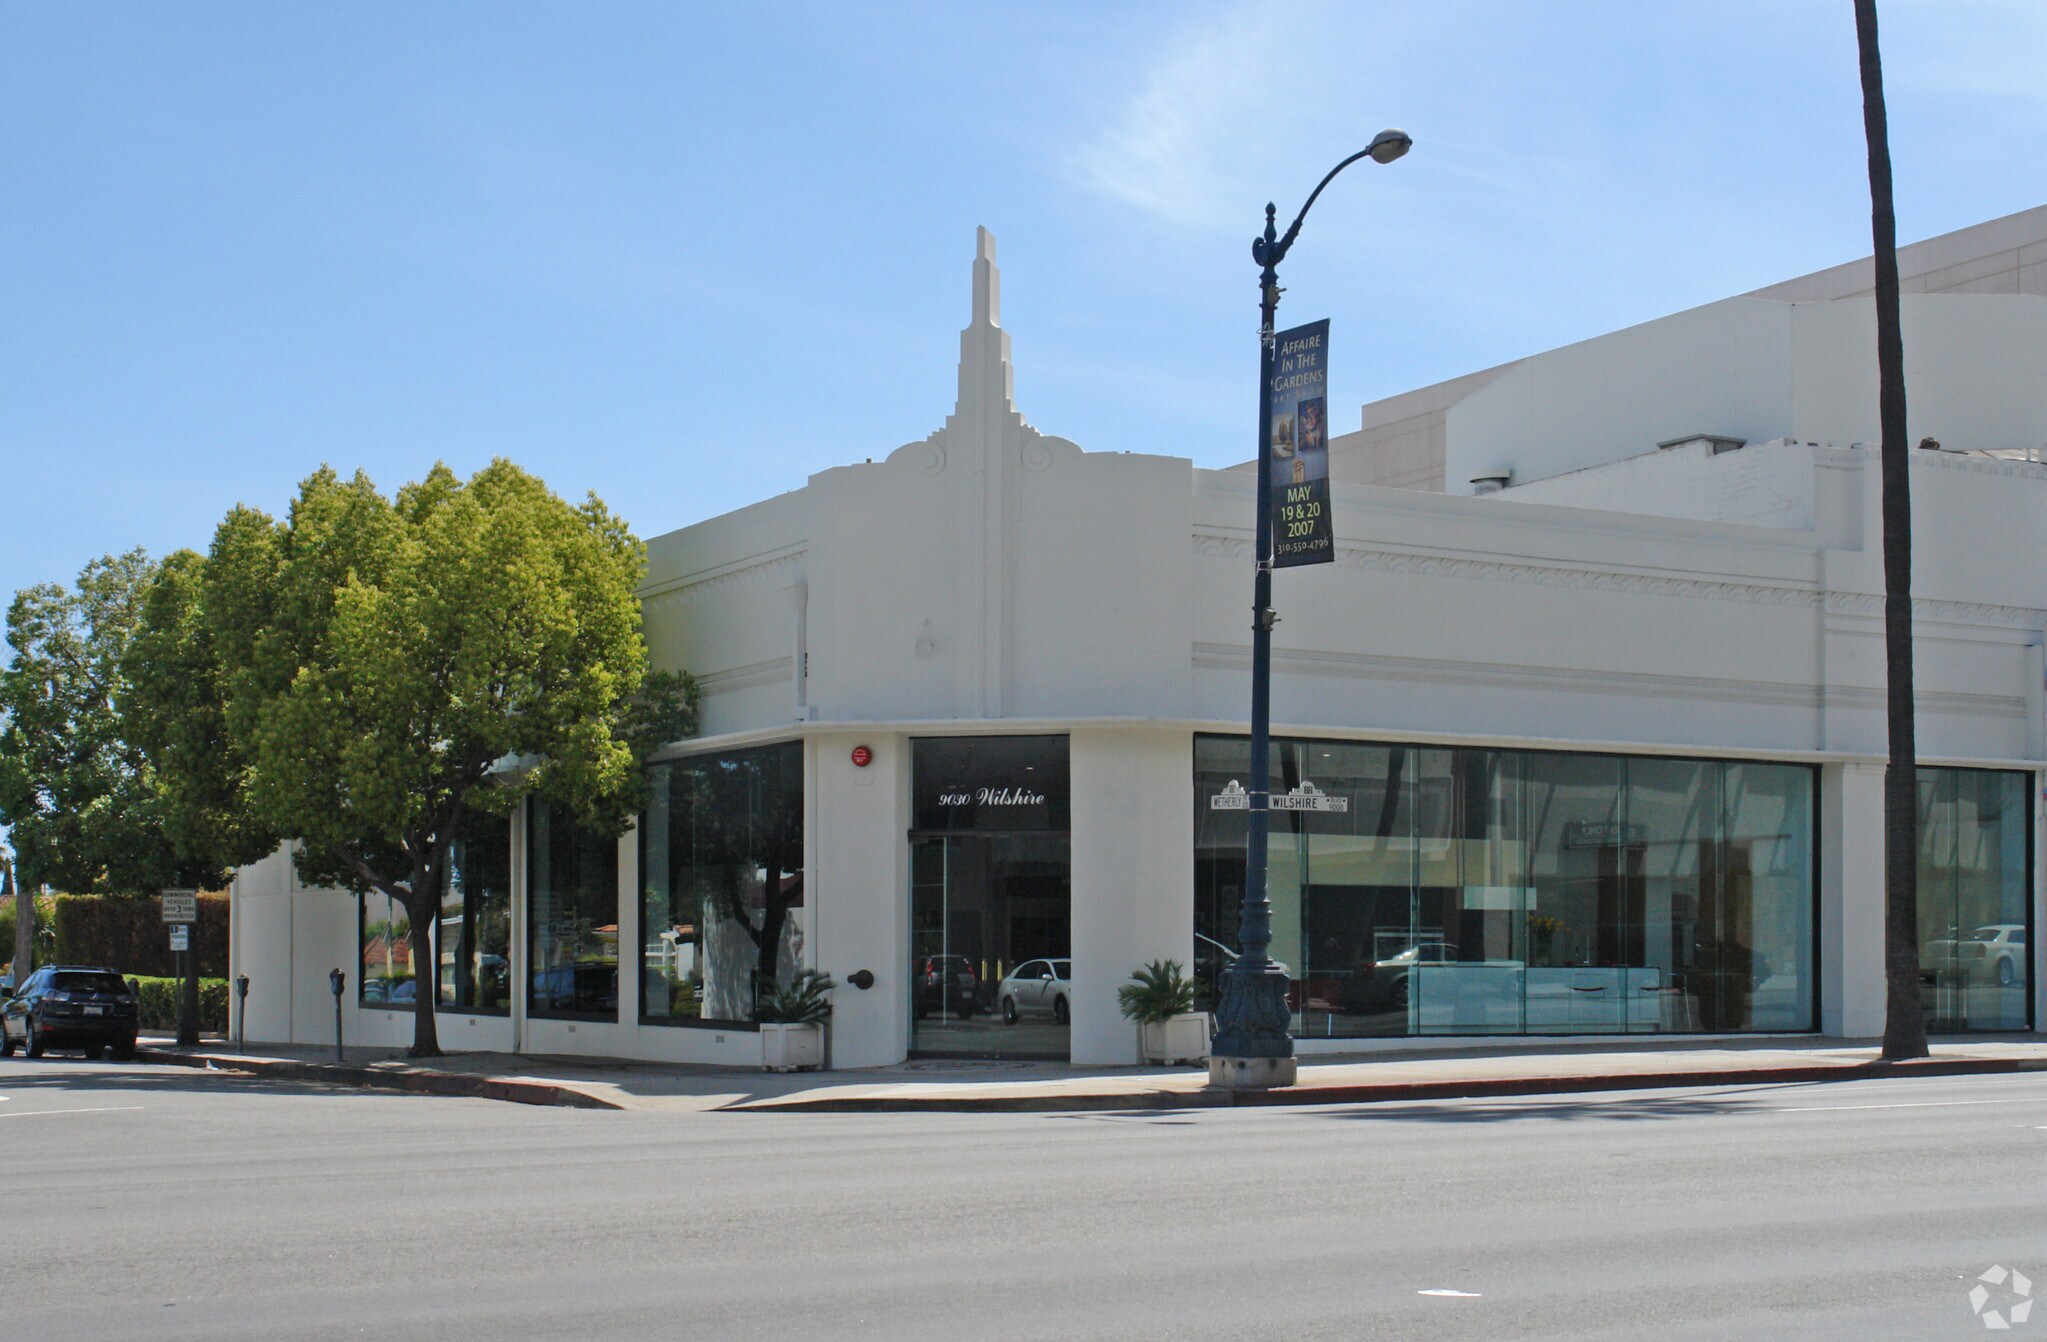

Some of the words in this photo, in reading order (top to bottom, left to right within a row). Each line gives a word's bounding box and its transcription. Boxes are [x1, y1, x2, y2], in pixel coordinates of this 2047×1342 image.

[1281, 334, 1321, 356] AFFAIRE
[1282, 358, 1294, 373] IN
[1296, 353, 1316, 369] THE
[1274, 369, 1323, 392] GARDENS
[1287, 485, 1311, 503] MAY
[1281, 506, 1294, 521] 19
[1296, 504, 1305, 519] &
[1306, 502, 1320, 518] 20
[1287, 520, 1315, 538] 2007
[938, 793, 971, 806] 9030
[975, 787, 1045, 806] Wilshire
[1272, 796, 1318, 809] WILSHIRE
[176, 904, 182, 913] 3
